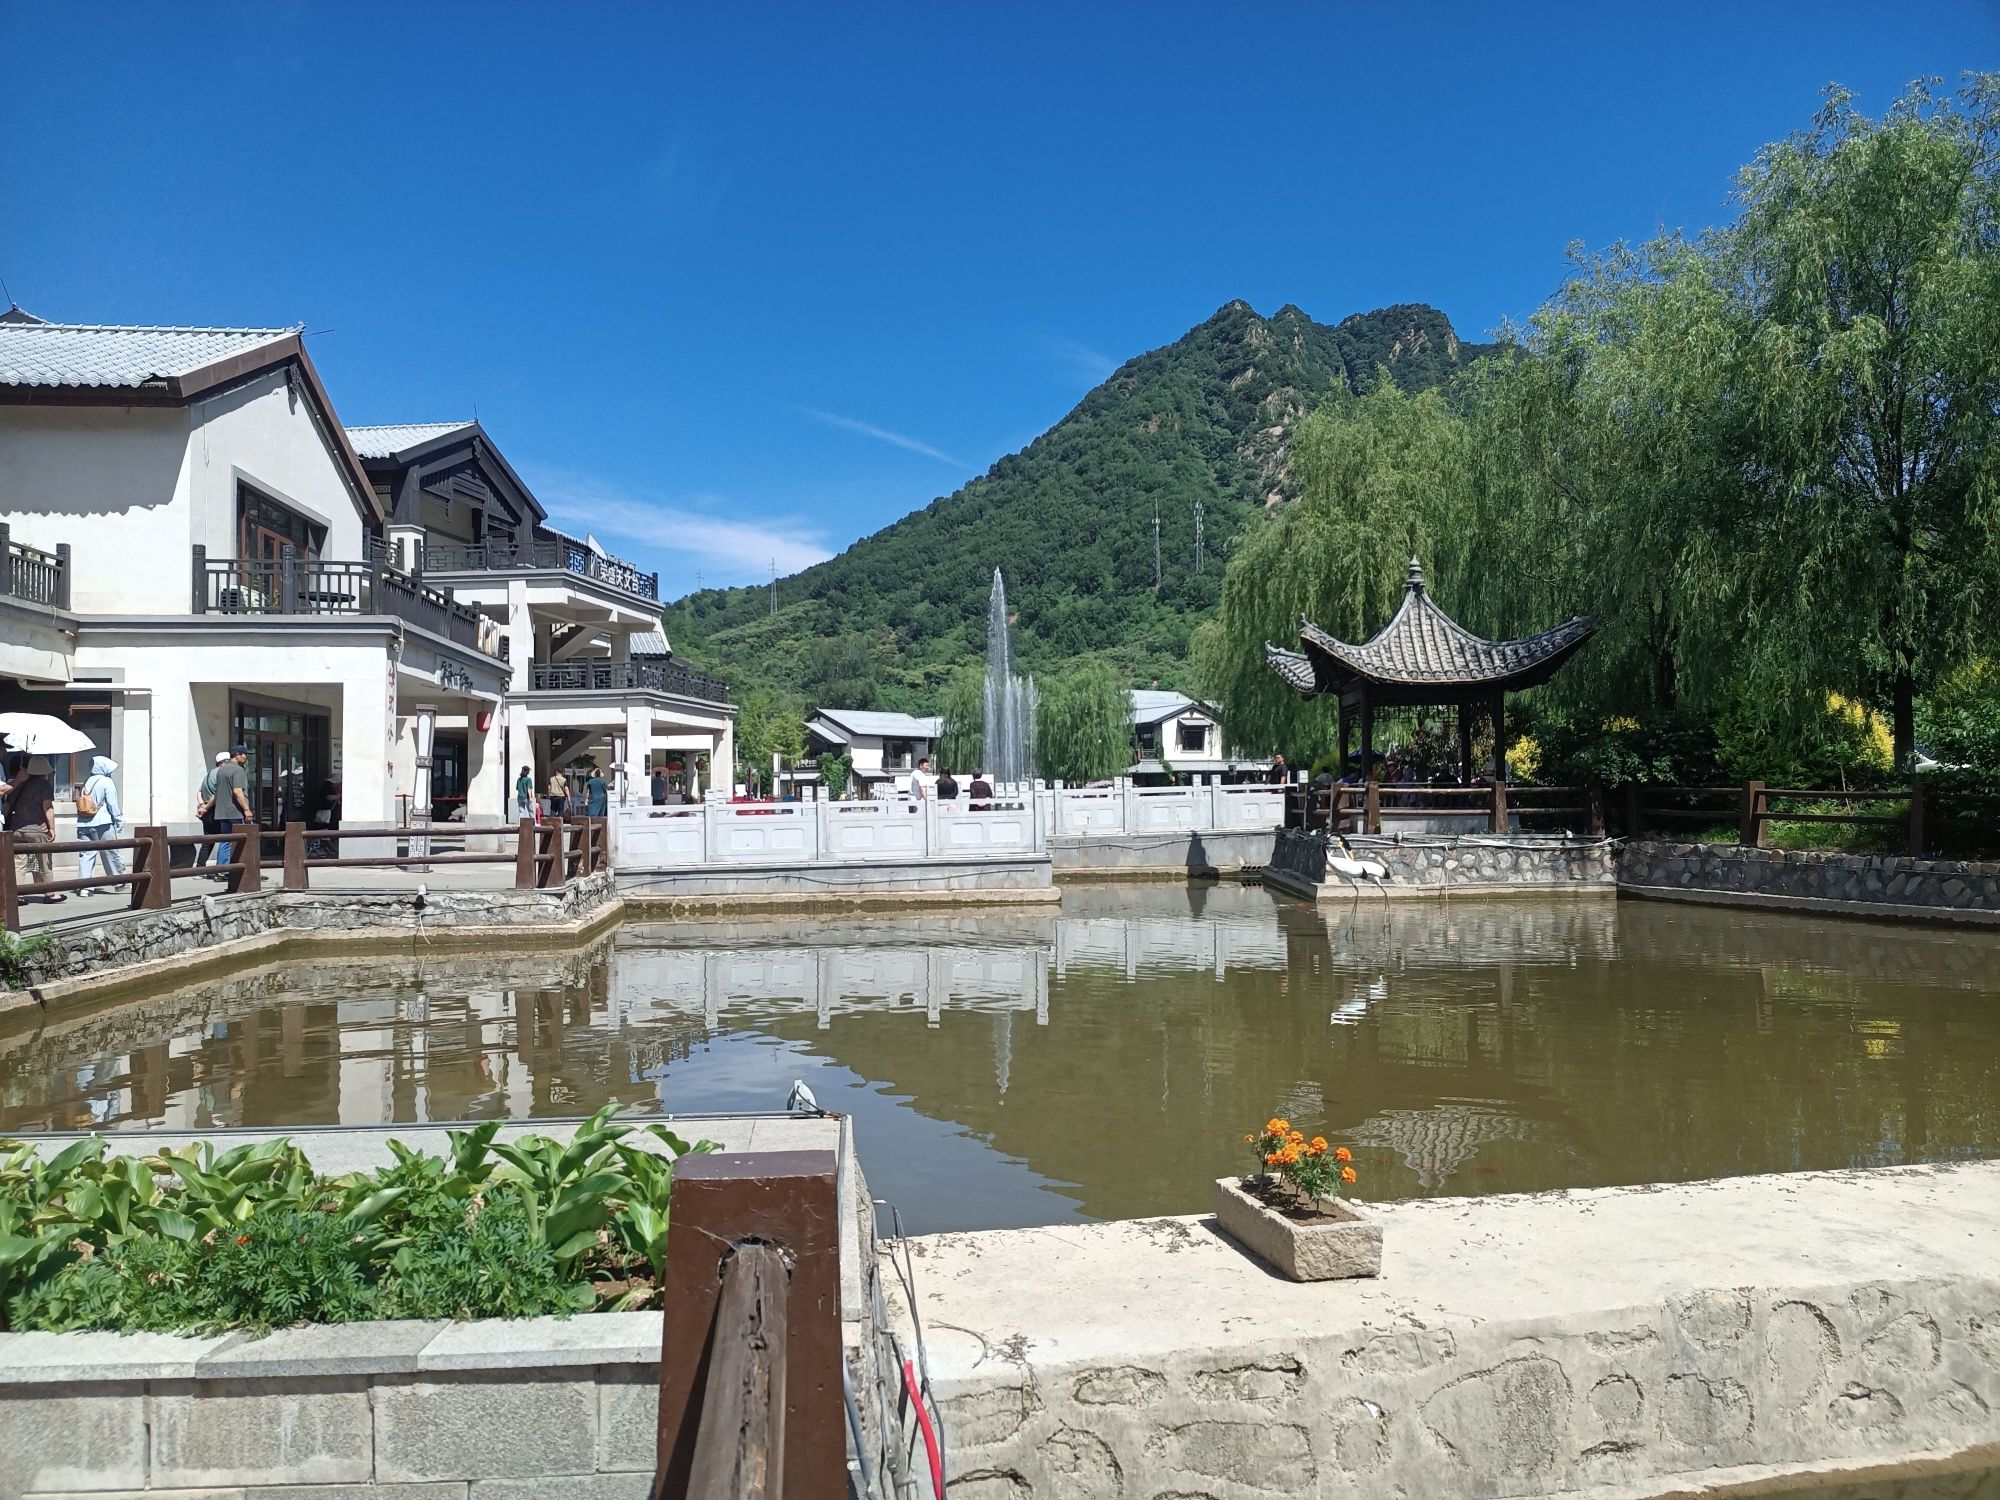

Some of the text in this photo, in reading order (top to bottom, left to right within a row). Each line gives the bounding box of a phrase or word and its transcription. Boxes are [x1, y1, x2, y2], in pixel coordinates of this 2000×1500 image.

[600, 560, 639, 593] 荣盛天文台
